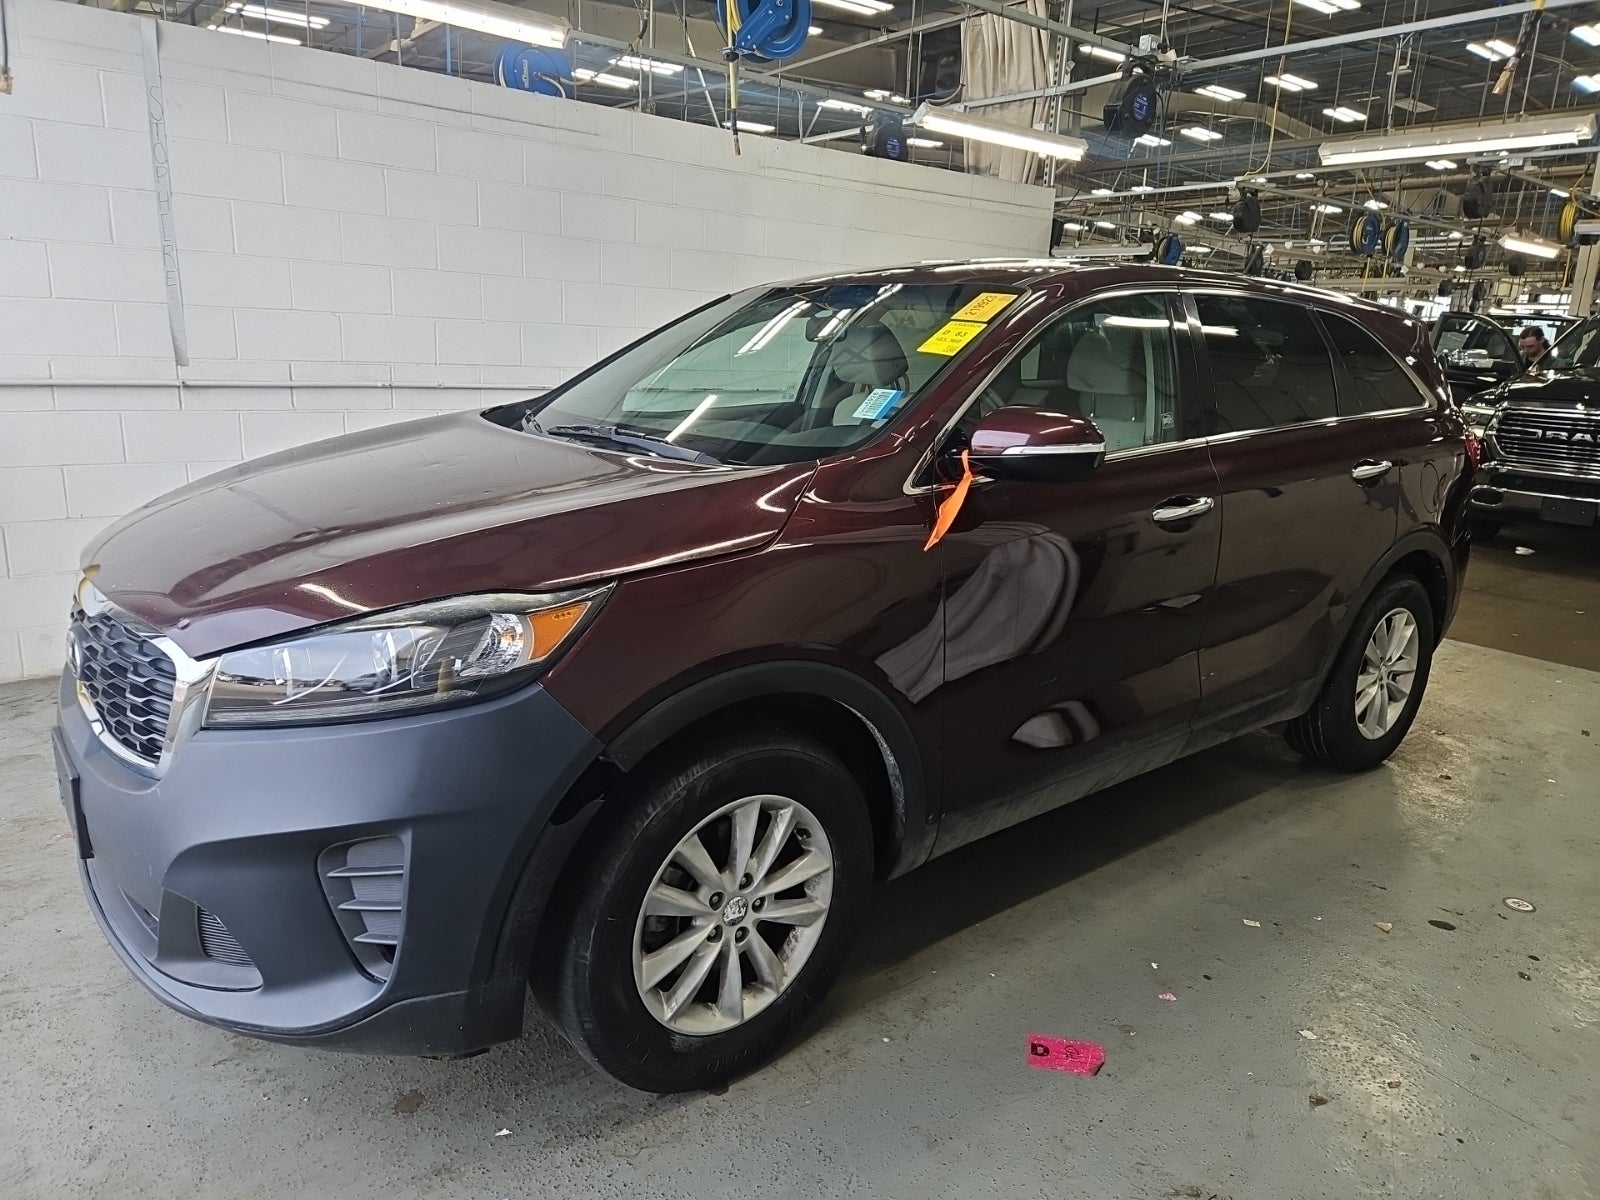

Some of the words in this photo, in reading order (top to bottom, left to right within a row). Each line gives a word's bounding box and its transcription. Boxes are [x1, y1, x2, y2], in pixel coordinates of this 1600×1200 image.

[149, 85, 169, 185] STOP
[157, 190, 178, 287] HERE
[1545, 430, 1600, 443] RA
